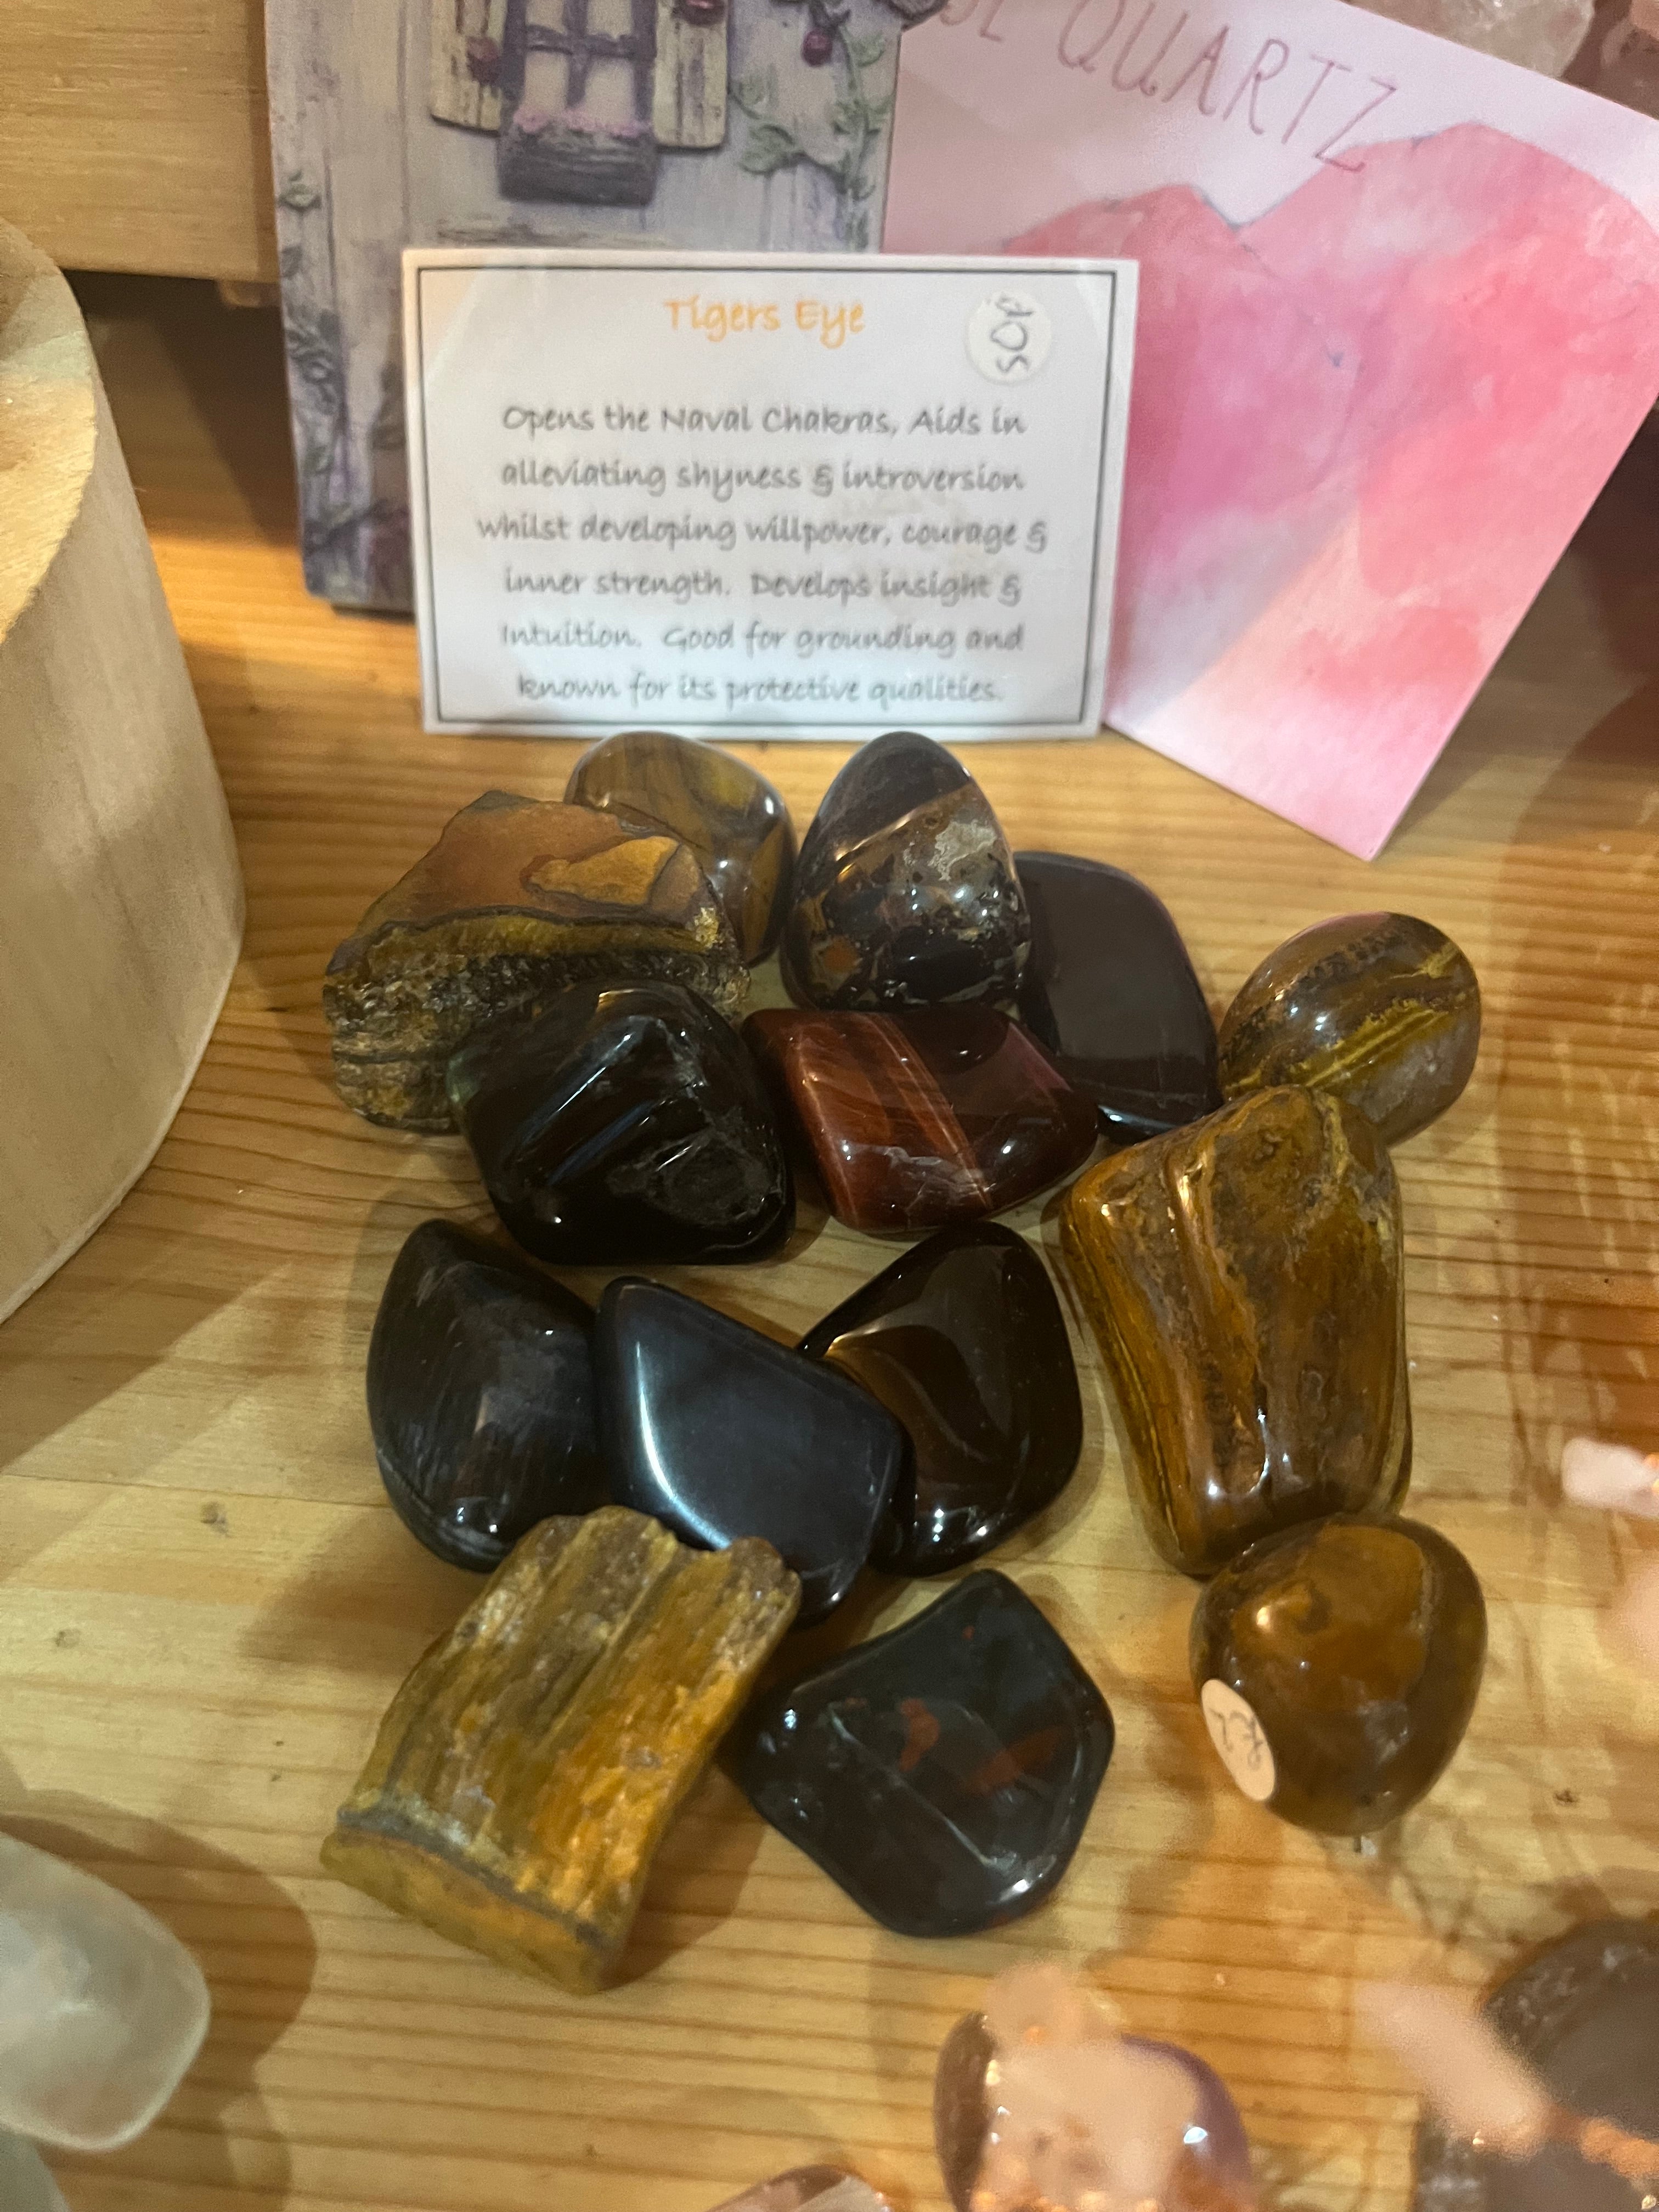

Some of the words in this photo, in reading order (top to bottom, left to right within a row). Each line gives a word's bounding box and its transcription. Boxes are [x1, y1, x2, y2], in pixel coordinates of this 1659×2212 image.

[1057, 0, 1398, 171] QUARTZ
[664, 295, 781, 342] Tigers
[795, 298, 866, 349] Eye
[503, 405, 594, 439] Opens
[605, 404, 650, 432] the
[661, 405, 753, 432] Naval
[762, 405, 896, 438] Chakras,
[909, 405, 981, 436] Aids
[991, 405, 1028, 435] in
[501, 458, 666, 497] alleviating
[676, 460, 802, 503] shyness
[842, 456, 1026, 492] introversion
[476, 511, 569, 541] whilst
[580, 513, 737, 552] developing
[745, 514, 891, 554] willpower,
[901, 521, 1017, 555] courage
[504, 566, 584, 595] inner
[593, 569, 731, 605] strength.
[750, 571, 872, 608] Develops
[880, 567, 992, 608] insight
[661, 623, 735, 655] Good
[744, 619, 788, 660] for
[796, 622, 956, 661] grounding
[966, 621, 1026, 652] and
[517, 671, 621, 701] known
[628, 666, 672, 711] for
[678, 673, 716, 701] its
[724, 674, 861, 713] protective
